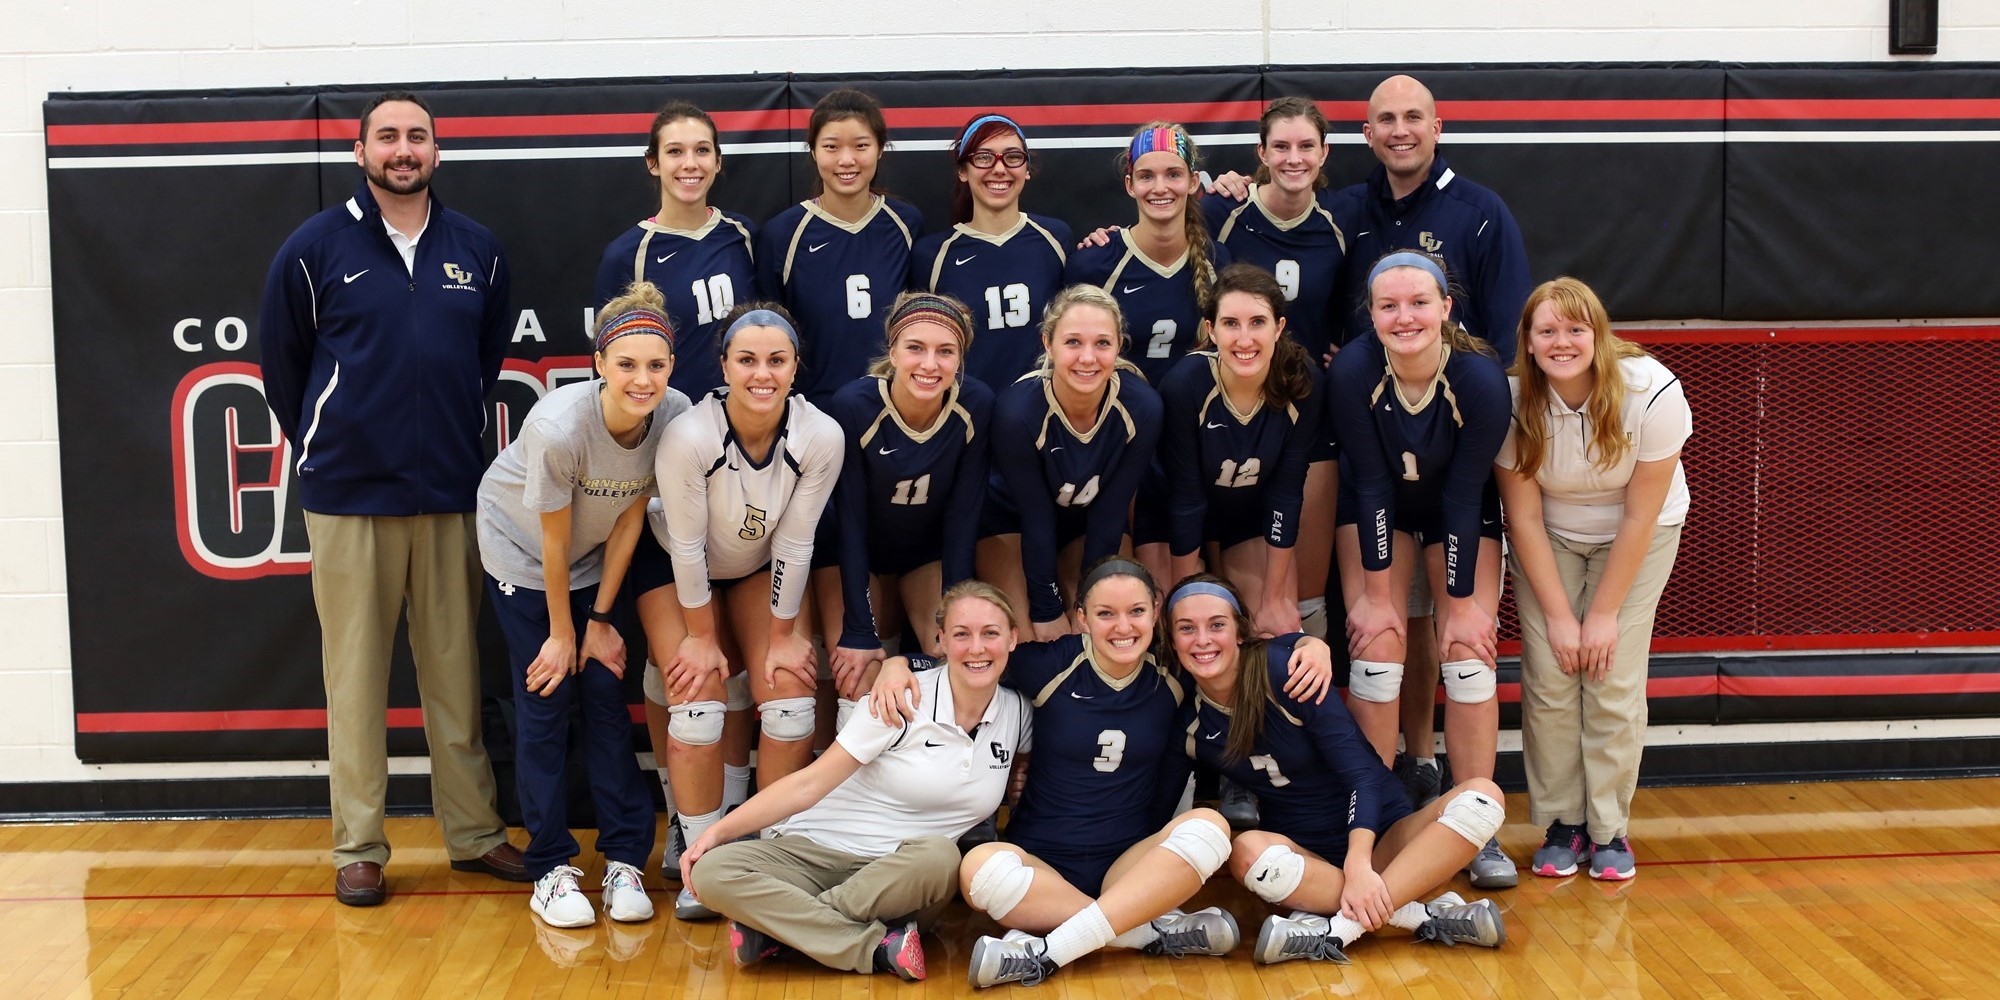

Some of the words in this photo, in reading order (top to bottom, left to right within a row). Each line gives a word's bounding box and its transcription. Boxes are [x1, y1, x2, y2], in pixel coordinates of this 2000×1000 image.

[442, 284, 477, 292] VOLLEYBALL
[691, 273, 735, 325] 10
[845, 274, 872, 319] 6
[1275, 259, 1300, 301] 9
[985, 282, 1031, 329] 13
[1146, 319, 1178, 358] 2
[1214, 457, 1261, 488] 12
[1402, 451, 1420, 481] 1
[891, 473, 930, 505] 11
[1056, 474, 1100, 507] 14
[738, 504, 766, 541] 5
[1376, 508, 1388, 560] GOLDEN
[1447, 533, 1458, 587] EAGLES
[772, 558, 786, 608] EAGLES
[1093, 729, 1127, 773] 3
[1249, 753, 1291, 788] 7
